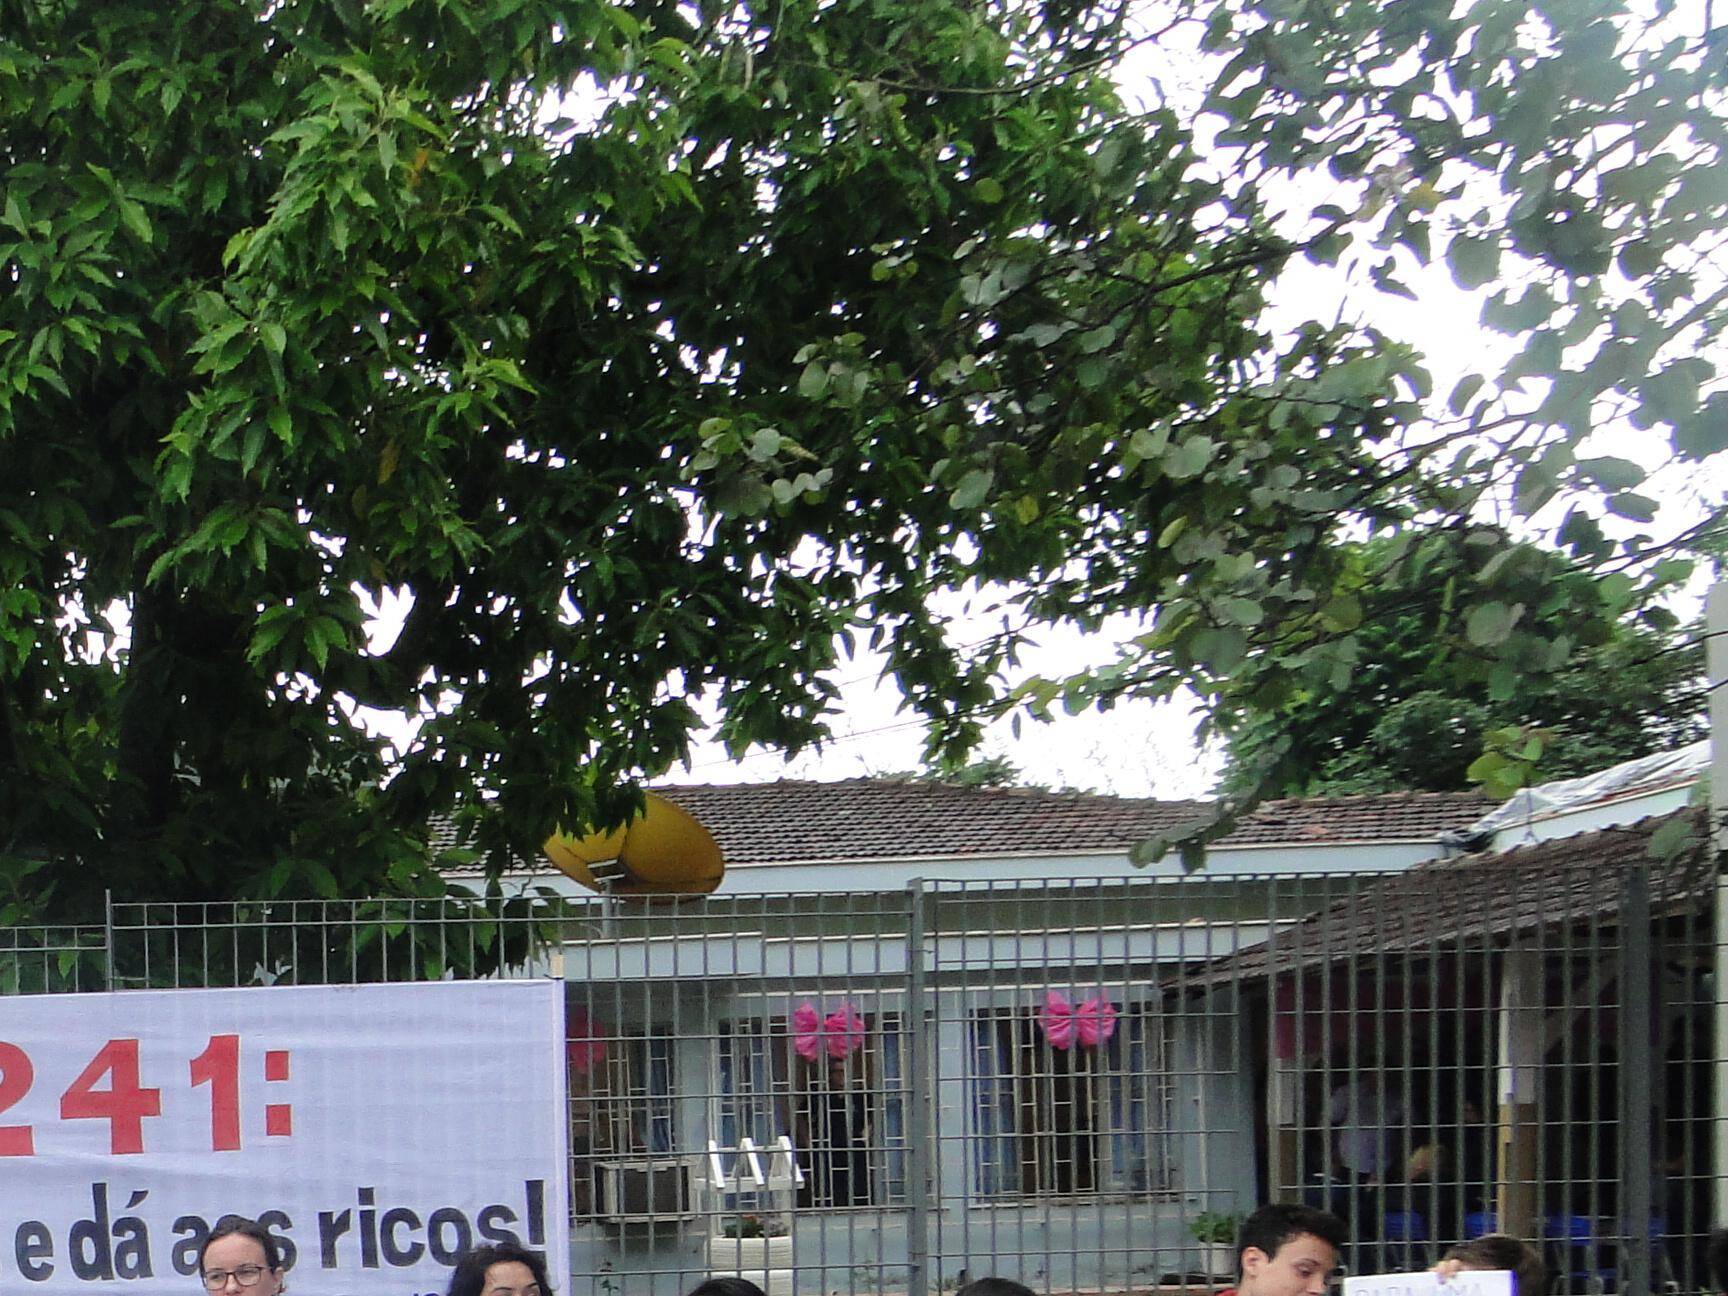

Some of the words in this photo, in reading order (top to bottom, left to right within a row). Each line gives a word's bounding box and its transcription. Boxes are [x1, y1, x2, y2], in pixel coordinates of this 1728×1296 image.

[14, 1219, 55, 1282] e
[72, 1181, 154, 1282] dá
[171, 1210, 298, 1277] as
[317, 1179, 547, 1268] ricos!
